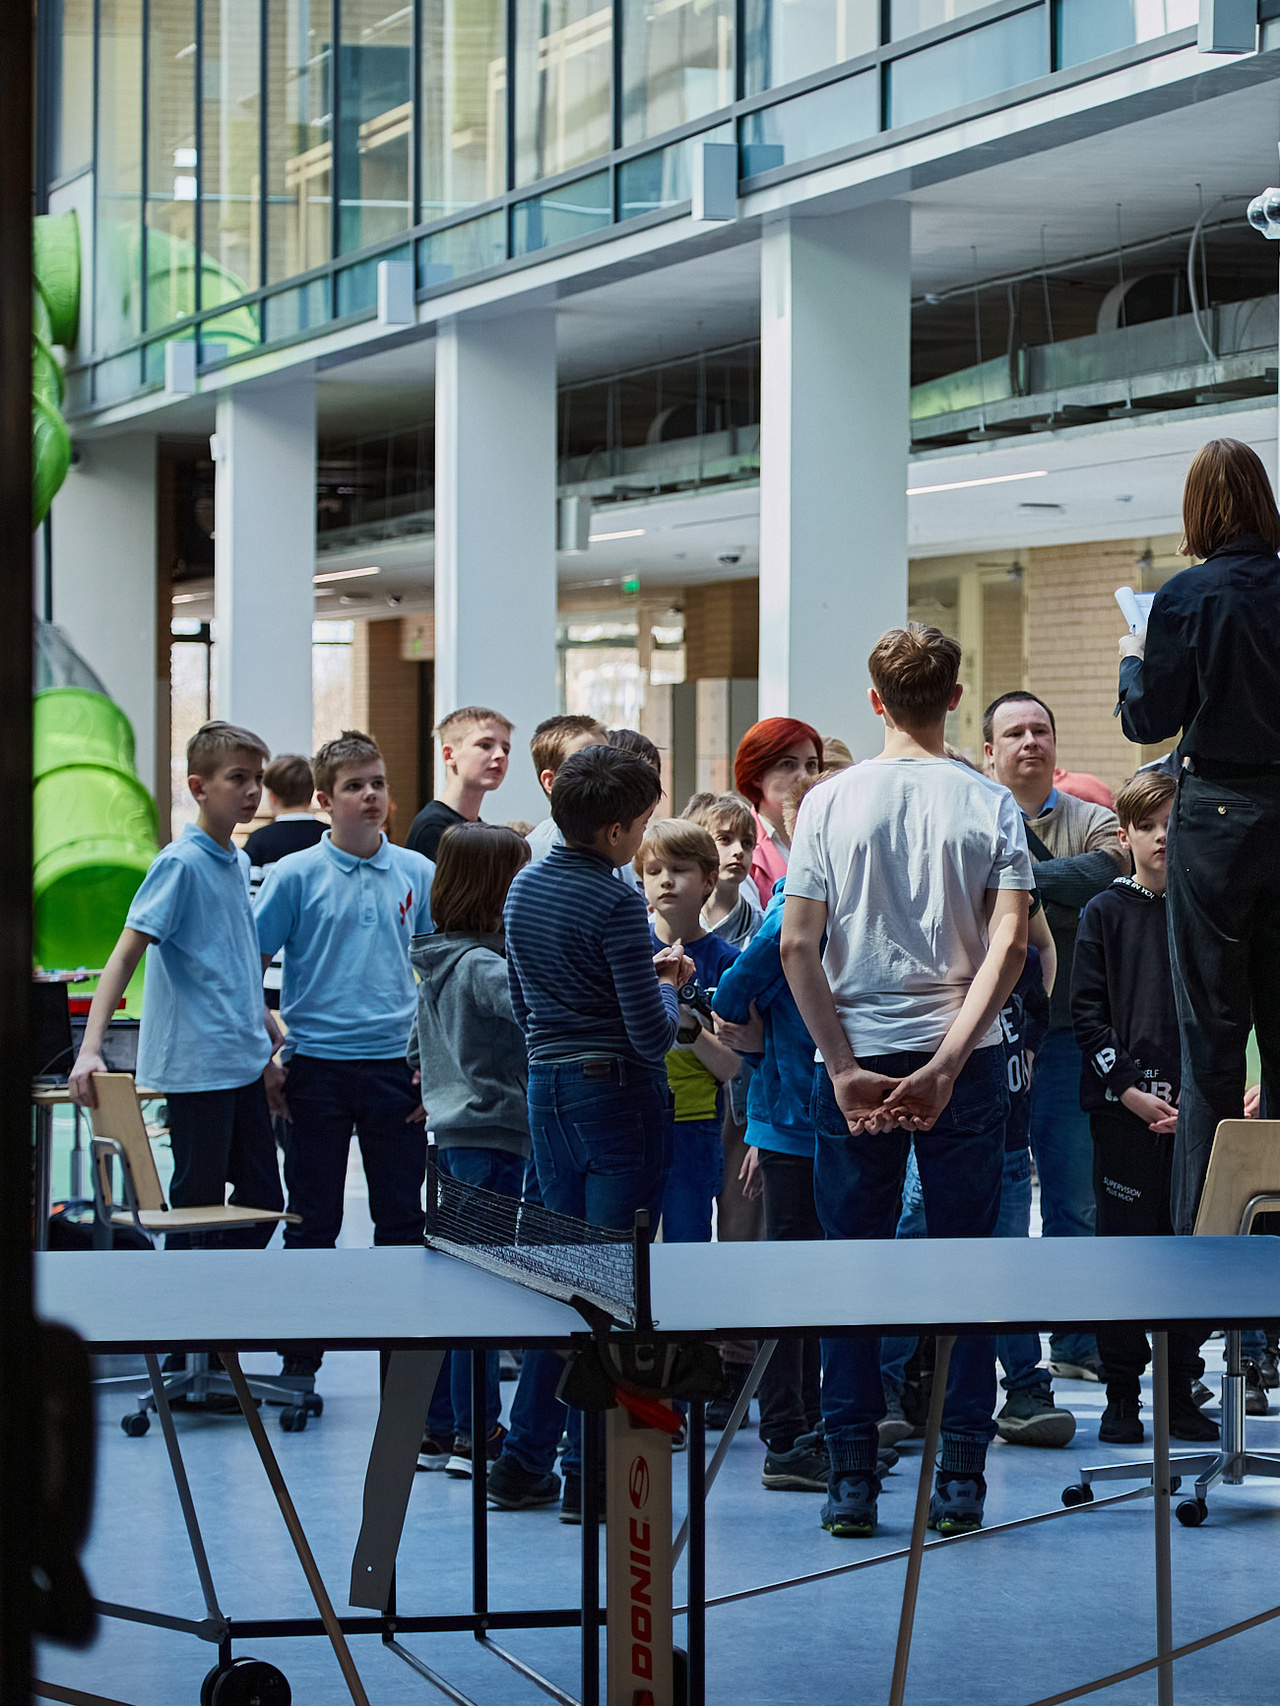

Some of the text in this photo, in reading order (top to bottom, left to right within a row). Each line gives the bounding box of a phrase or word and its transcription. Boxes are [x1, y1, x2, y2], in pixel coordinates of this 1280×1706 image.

[1131, 882, 1142, 891] IN
[1091, 1047, 1116, 1078] B
[1103, 1176, 1141, 1198] SUPERVISION
[630, 1517, 653, 1681] DONIC
